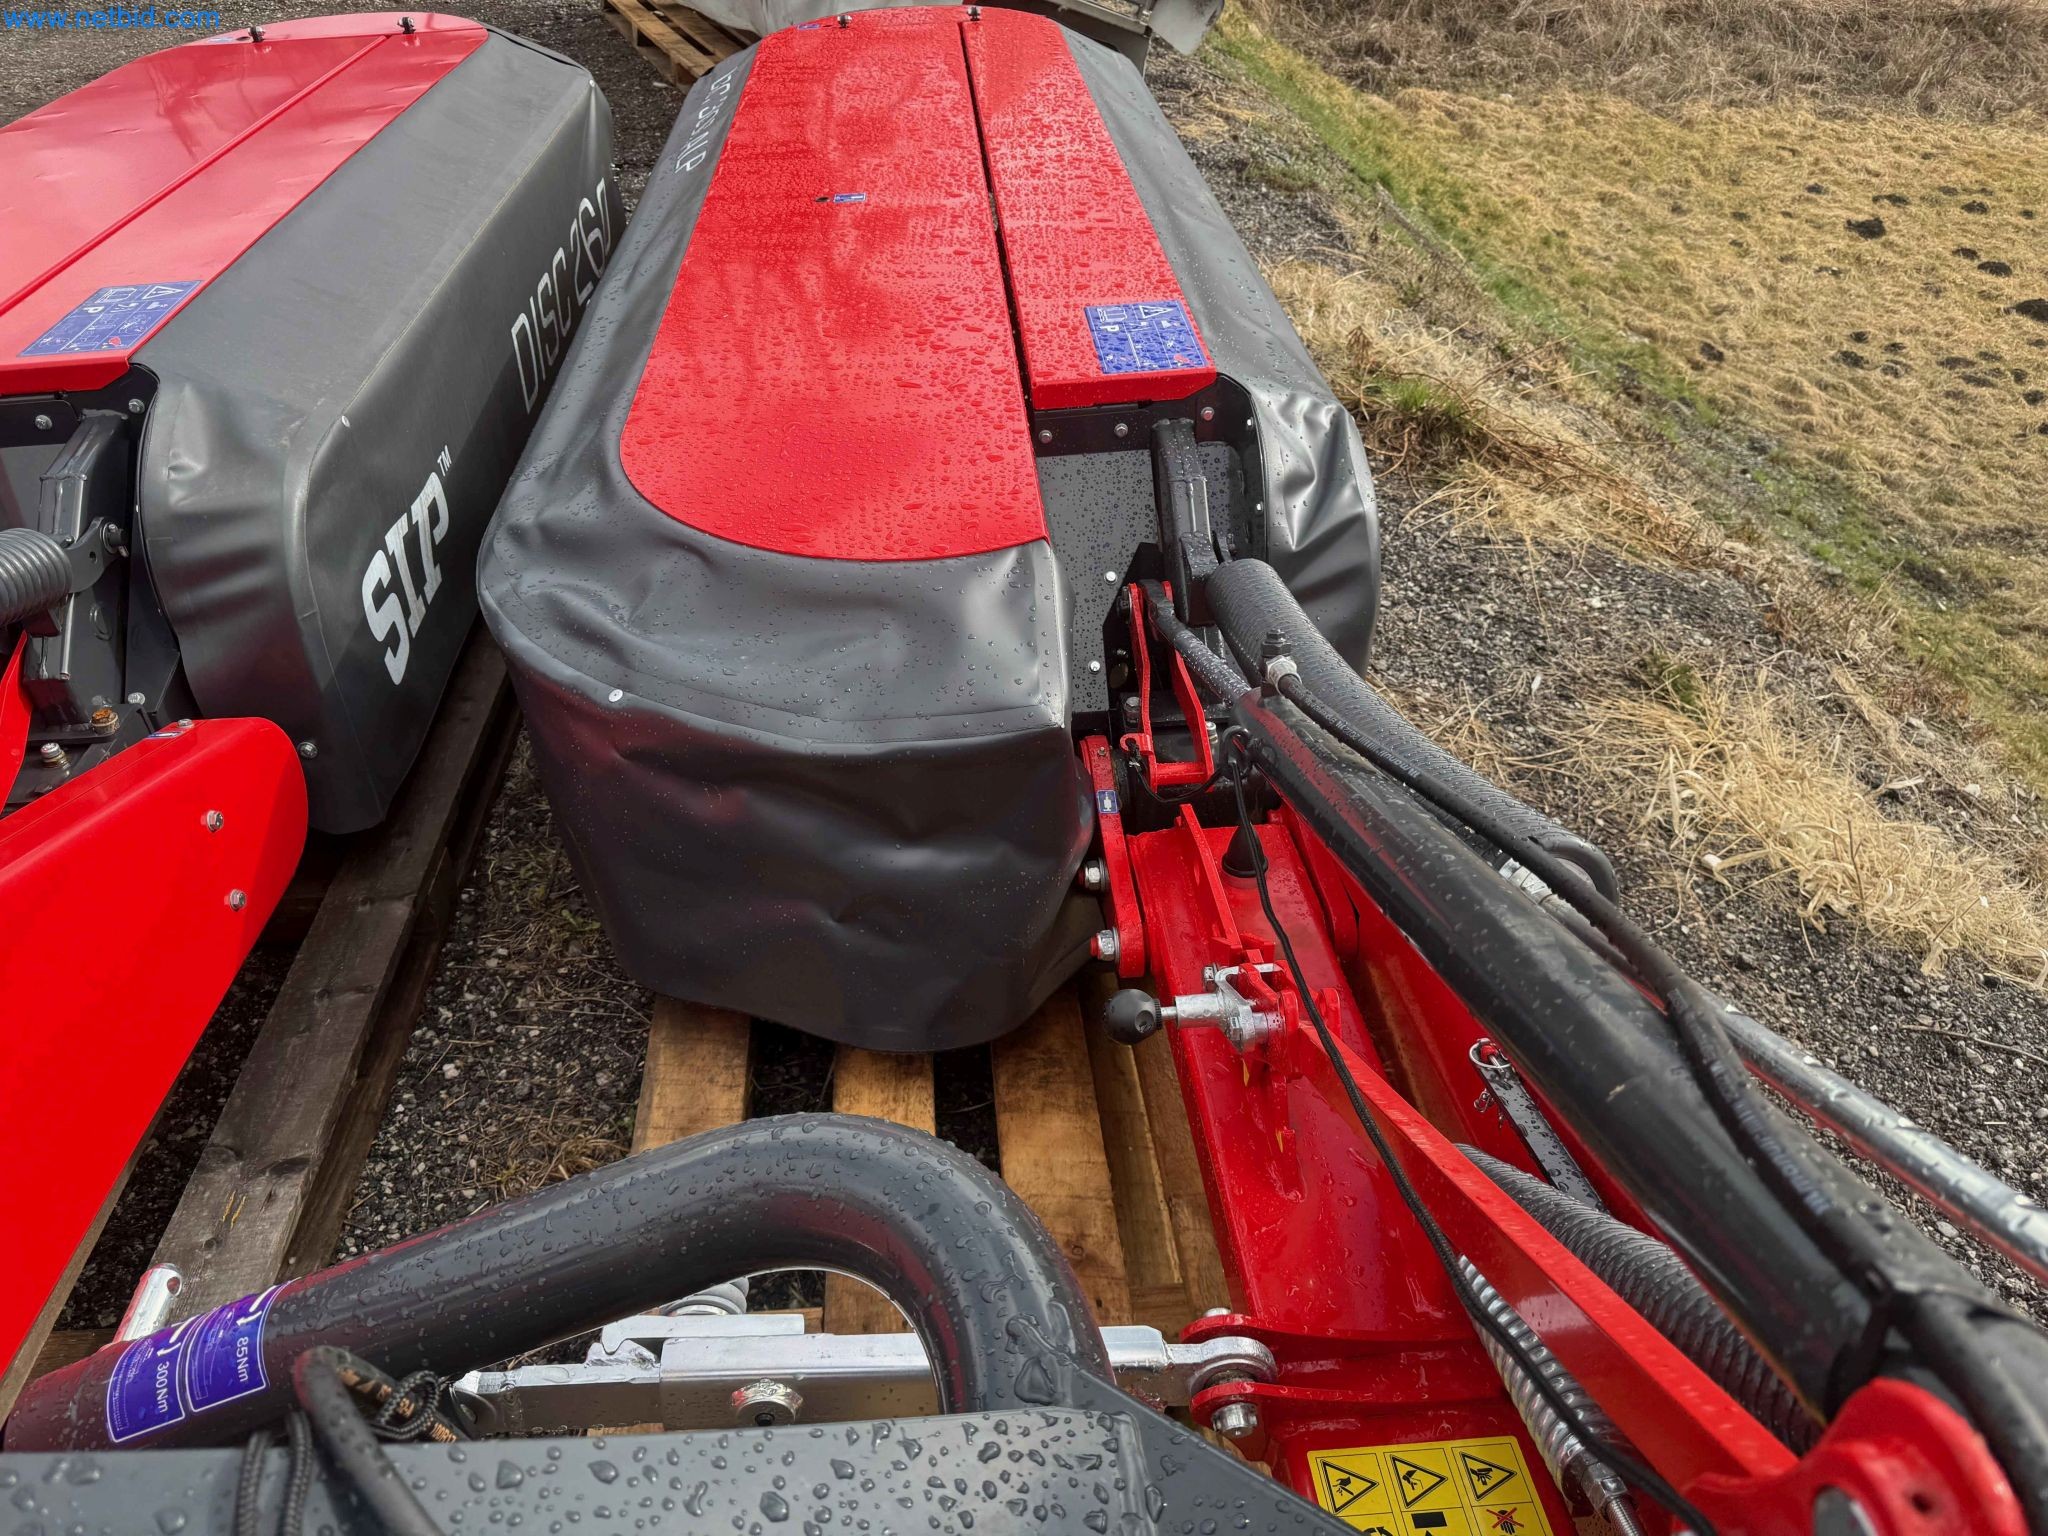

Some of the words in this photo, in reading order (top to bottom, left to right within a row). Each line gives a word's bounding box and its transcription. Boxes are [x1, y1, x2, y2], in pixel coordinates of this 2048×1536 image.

[511, 246, 572, 415] DISC
[570, 177, 611, 306] 260
[361, 471, 450, 686] SIP
[155, 1361, 170, 1413] 300Nm
[236, 1336, 249, 1382] 85Nm
